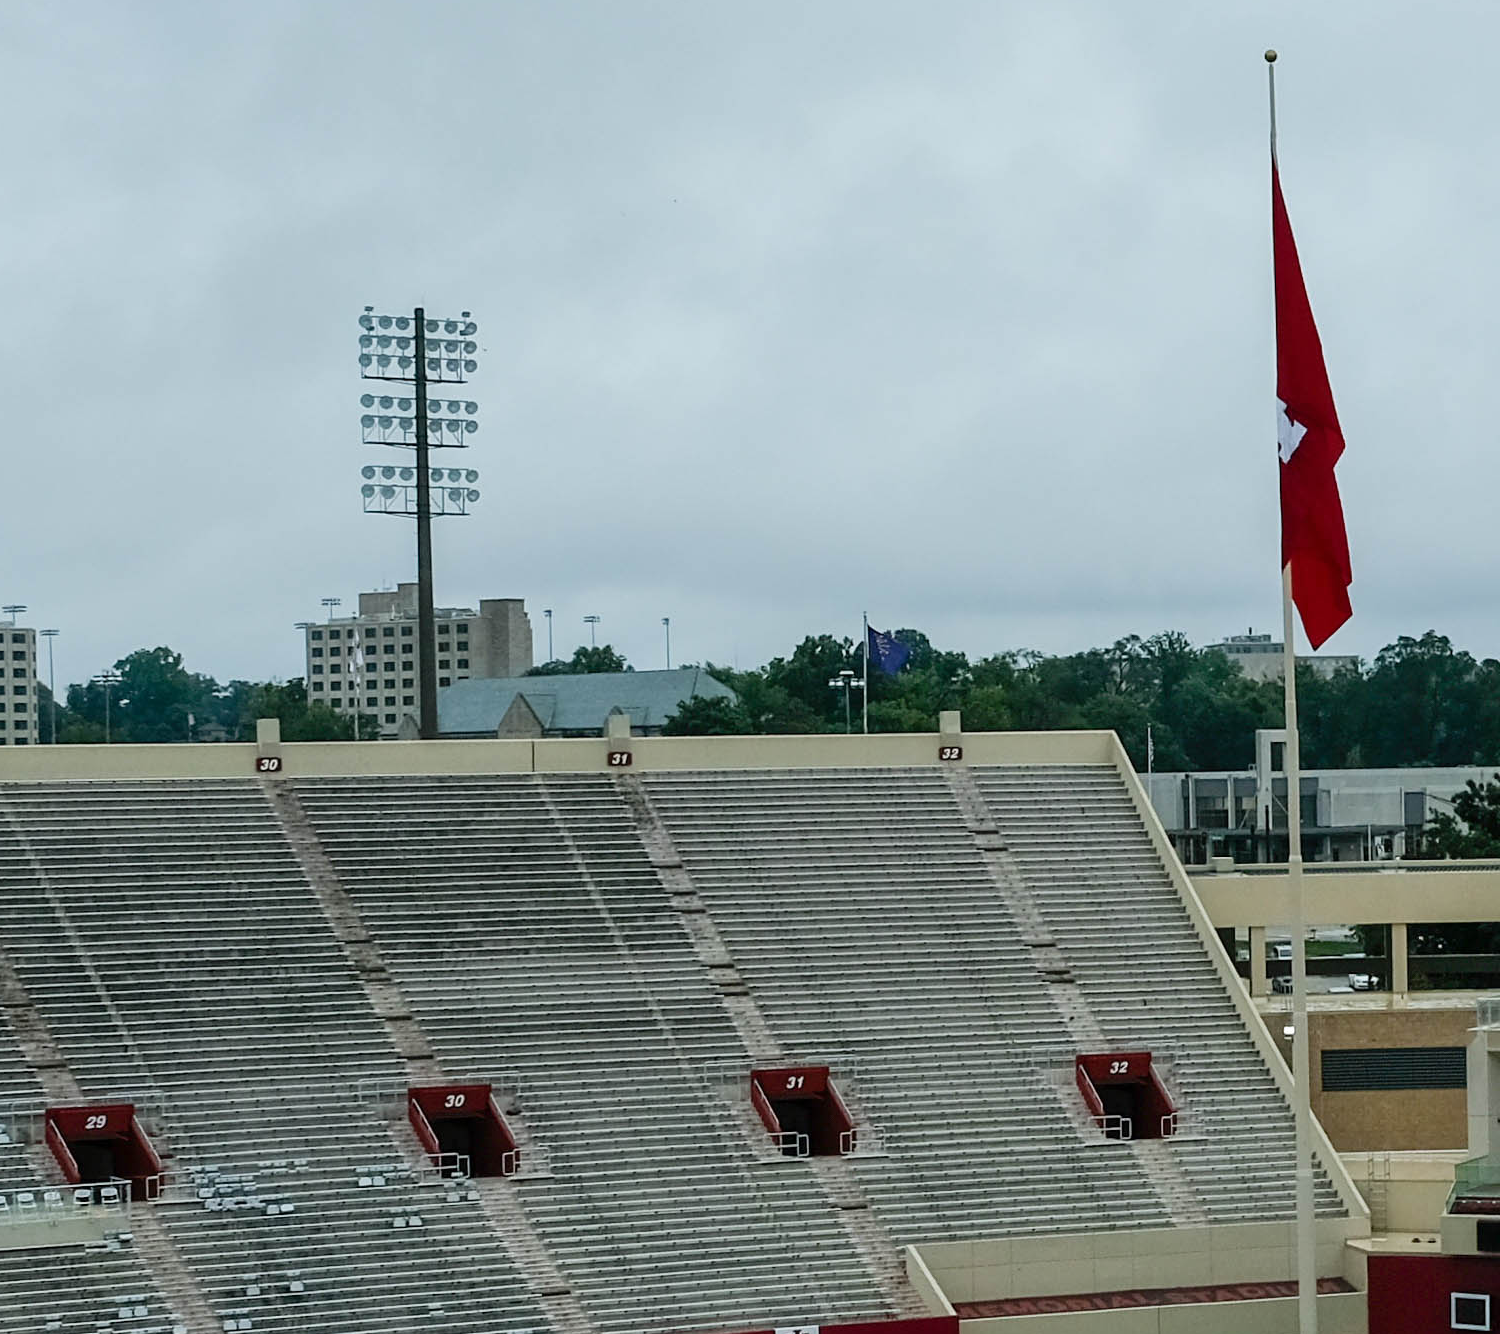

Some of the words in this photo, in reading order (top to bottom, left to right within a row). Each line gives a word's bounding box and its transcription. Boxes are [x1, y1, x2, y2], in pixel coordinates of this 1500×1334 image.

[612, 754, 628, 764] 31
[942, 749, 959, 759] 32
[260, 759, 279, 771] 30
[1110, 1061, 1128, 1073] 32
[786, 1077, 804, 1089] 31
[445, 1094, 465, 1108] 30
[86, 1115, 107, 1129] 29
